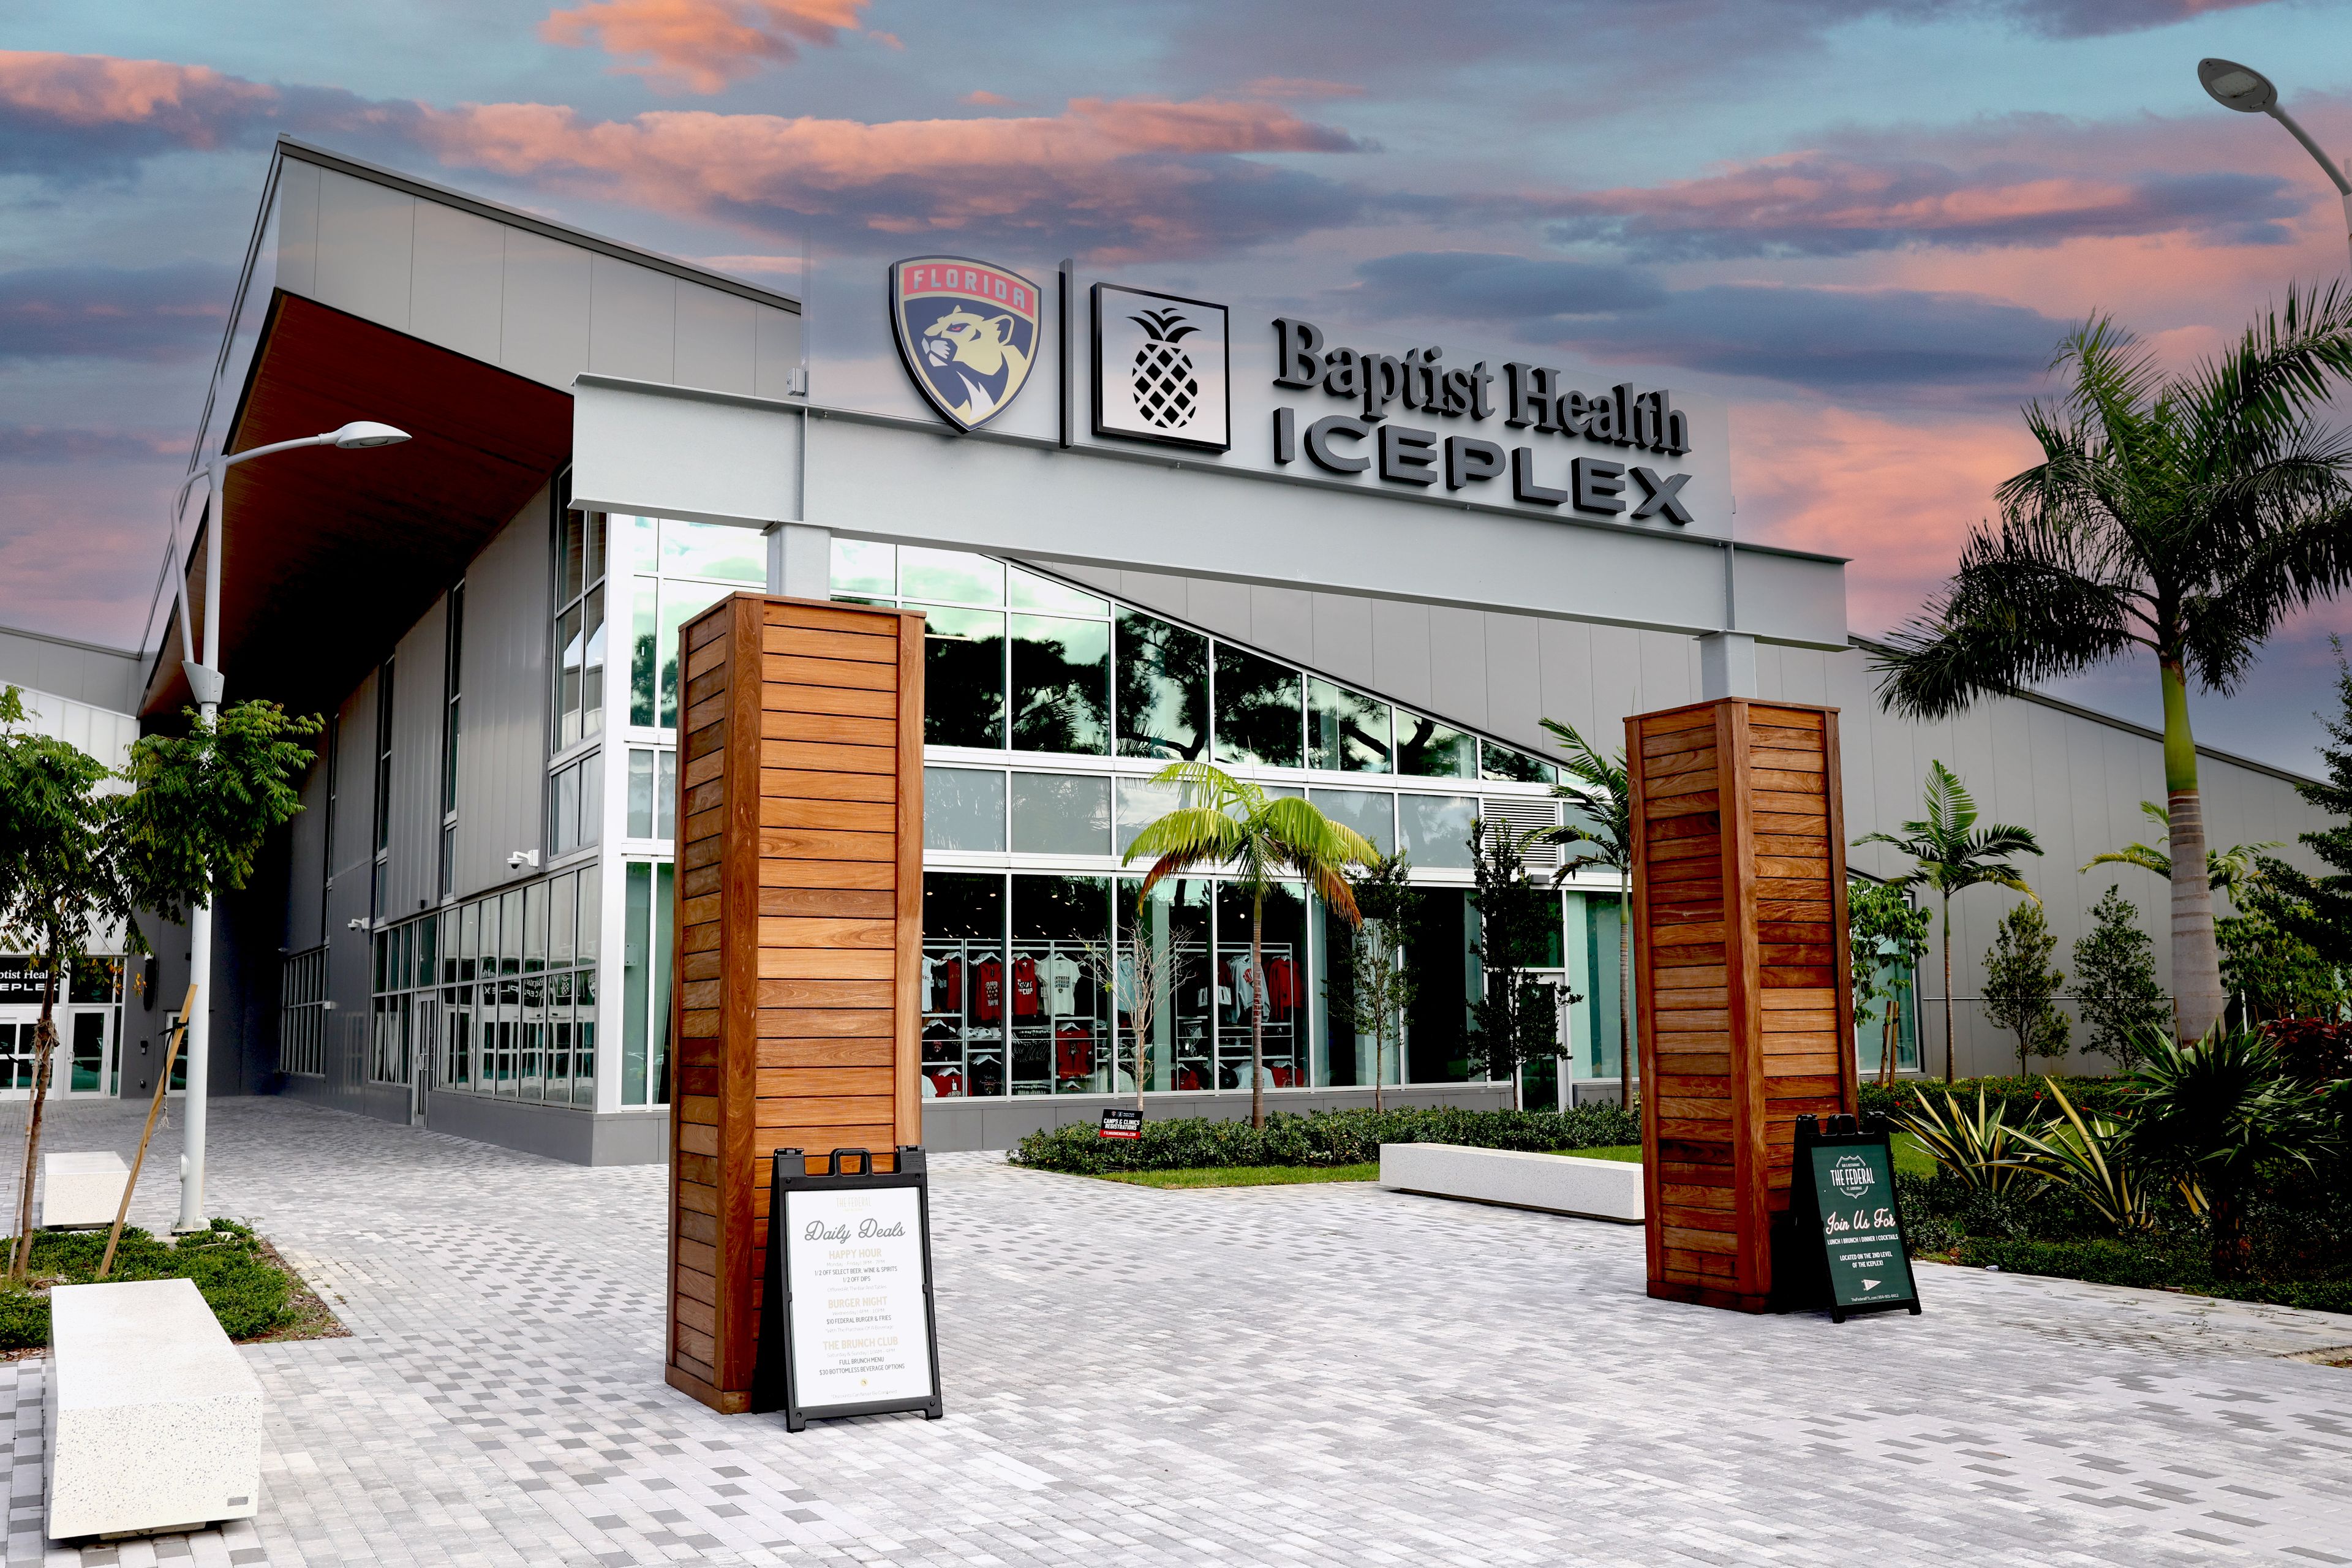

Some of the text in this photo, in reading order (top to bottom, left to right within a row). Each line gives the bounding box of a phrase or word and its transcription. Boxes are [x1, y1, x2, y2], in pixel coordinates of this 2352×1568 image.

[912, 267, 1025, 310] FLORIDA
[1271, 317, 1692, 456] Baptist Health
[1272, 405, 1695, 526] ICEPLEX
[23, 970, 58, 979] Heal
[1830, 1167, 1875, 1186] THE FEDERAL
[836, 1196, 872, 1208] THE FEDERAL
[1825, 1208, 1896, 1235] Join Us For
[804, 1218, 906, 1245] Daily Deals
[829, 1248, 882, 1259] HAPPY HOUR
[828, 1296, 888, 1309] BURGER NIGHT
[823, 1336, 898, 1351] THE BRUNCH CLUB
